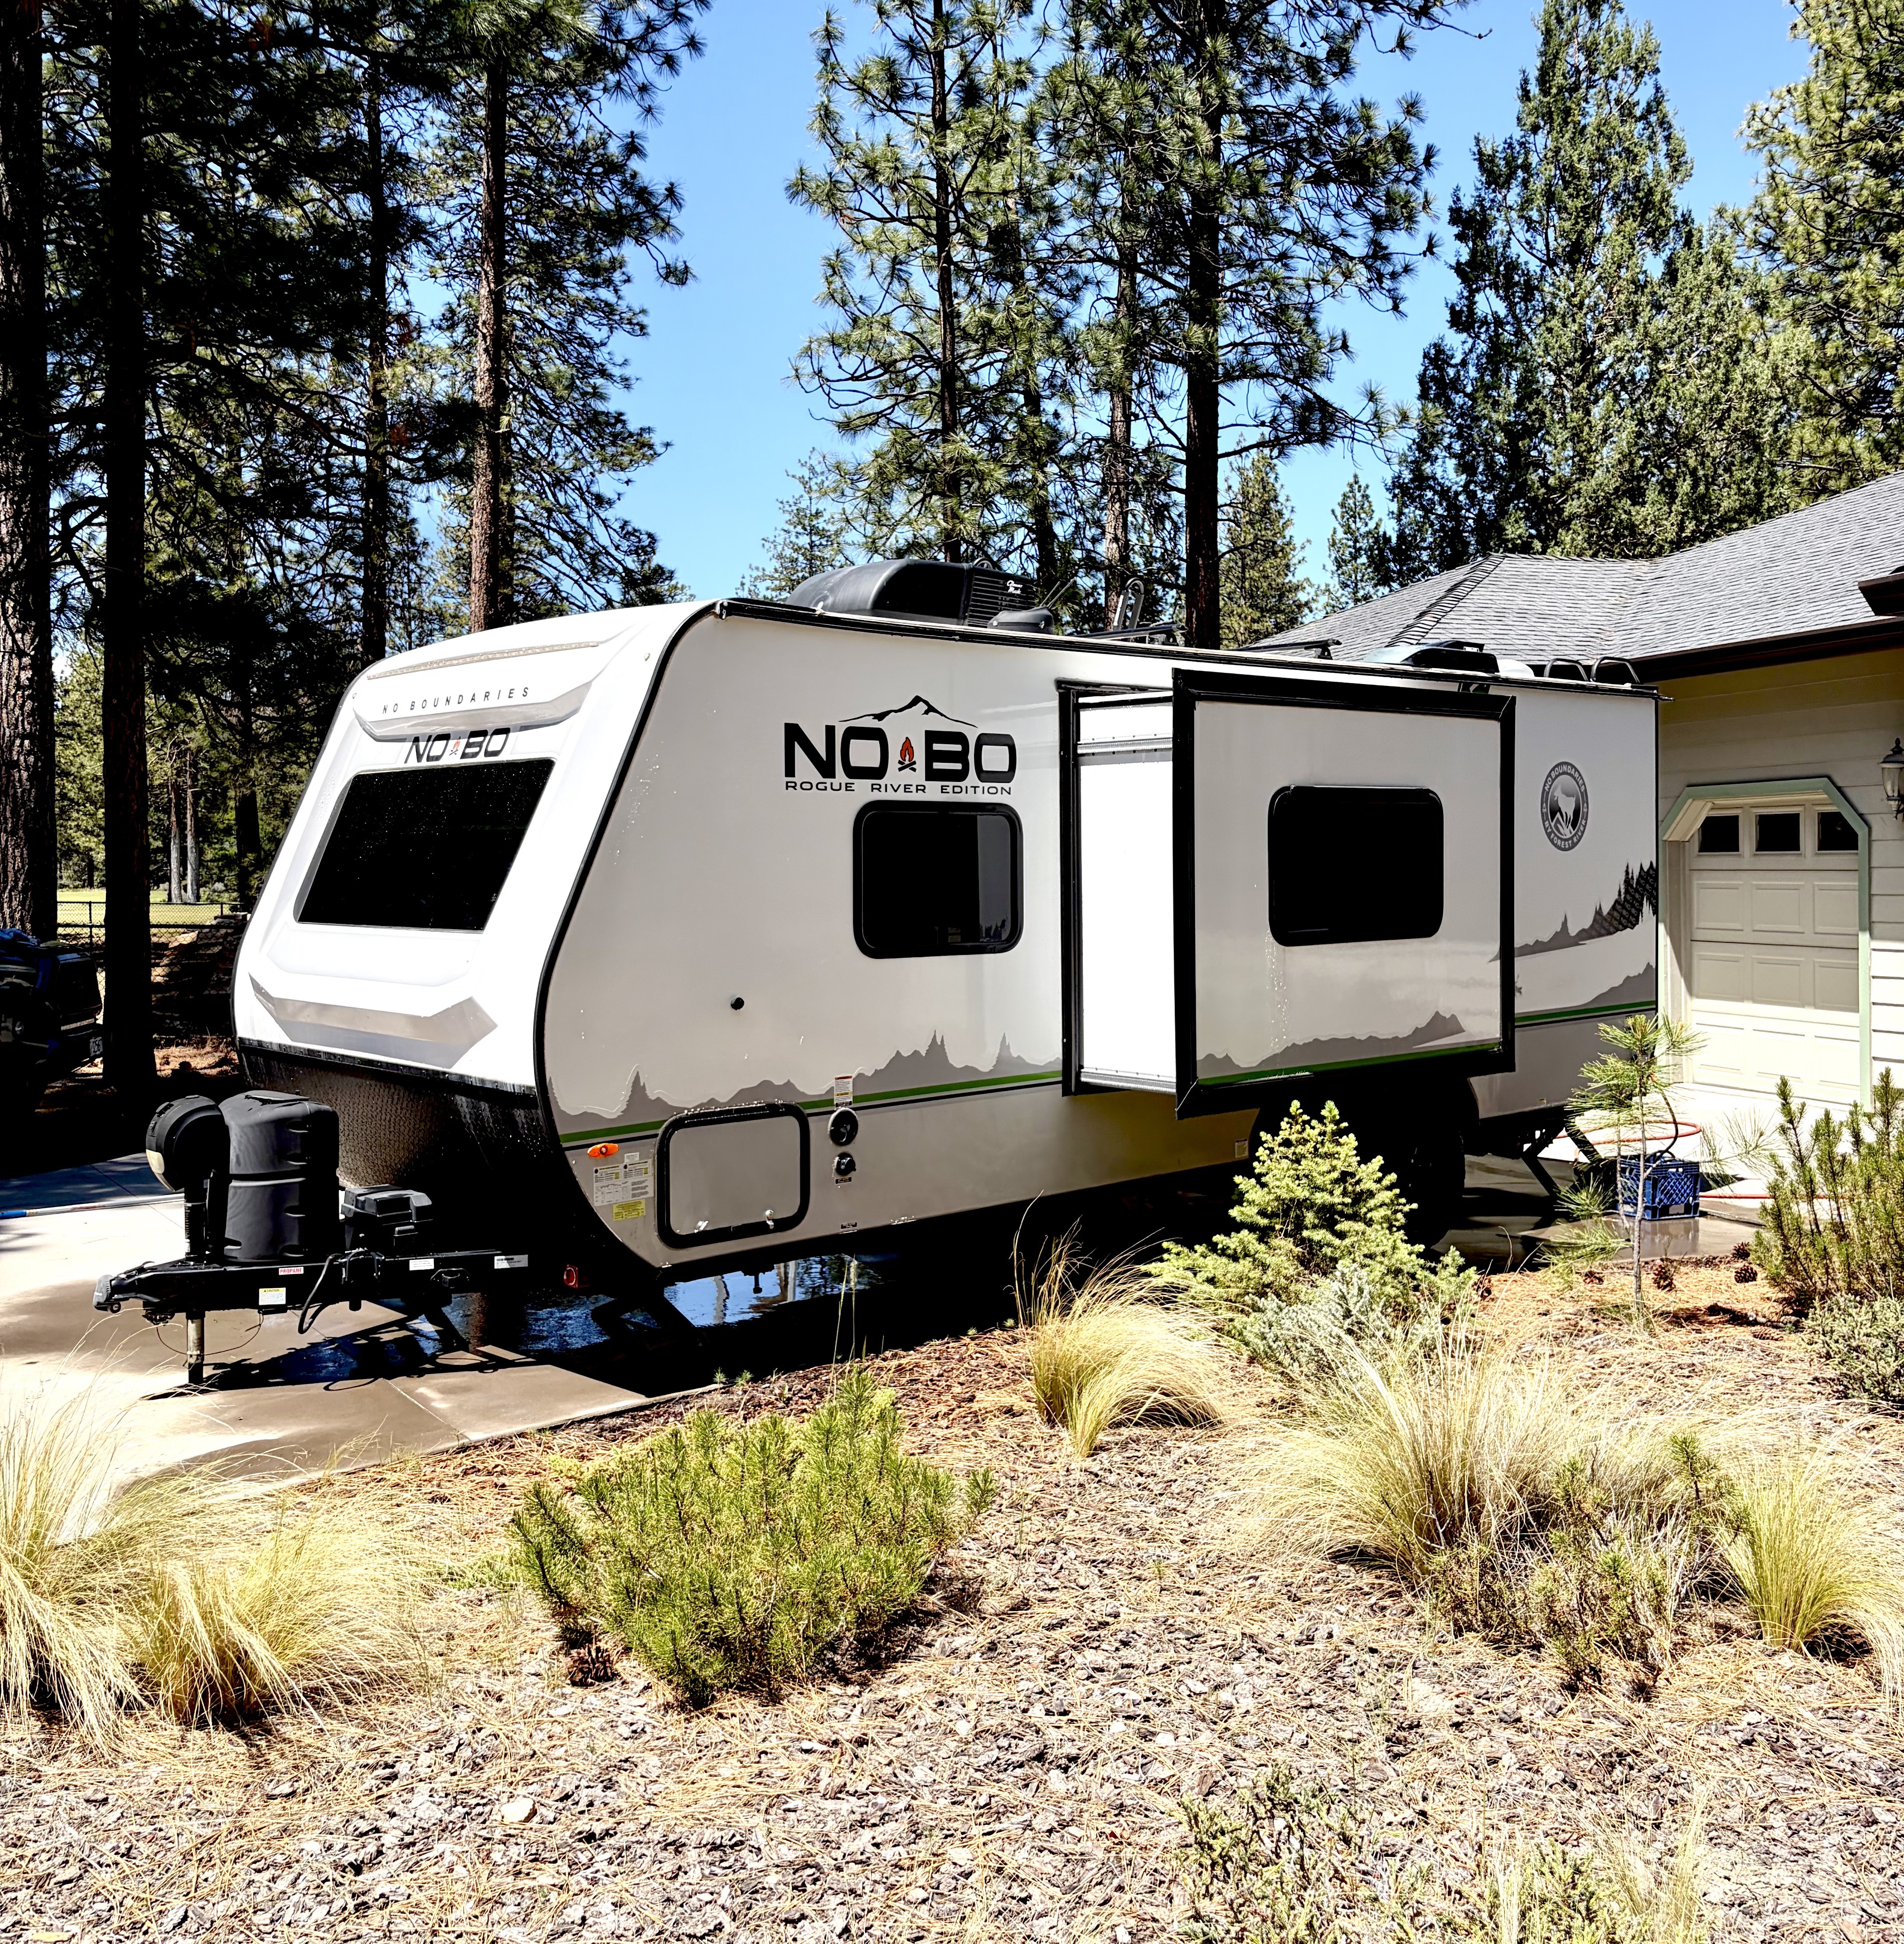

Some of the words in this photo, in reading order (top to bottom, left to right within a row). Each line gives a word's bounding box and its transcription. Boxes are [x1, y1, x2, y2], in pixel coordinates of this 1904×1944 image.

[382, 703, 398, 714] NO
[410, 687, 529, 711] BOUNDARIES
[785, 781, 855, 792] ROGUE
[871, 783, 926, 794] RIVER
[940, 785, 1012, 795] EDITION
[1545, 777, 1552, 792] NO
[1551, 764, 1585, 792] BOUNDARIES
[1544, 820, 1551, 833] BY
[1550, 833, 1572, 848] FOREST
[1573, 819, 1586, 842] RIVER
